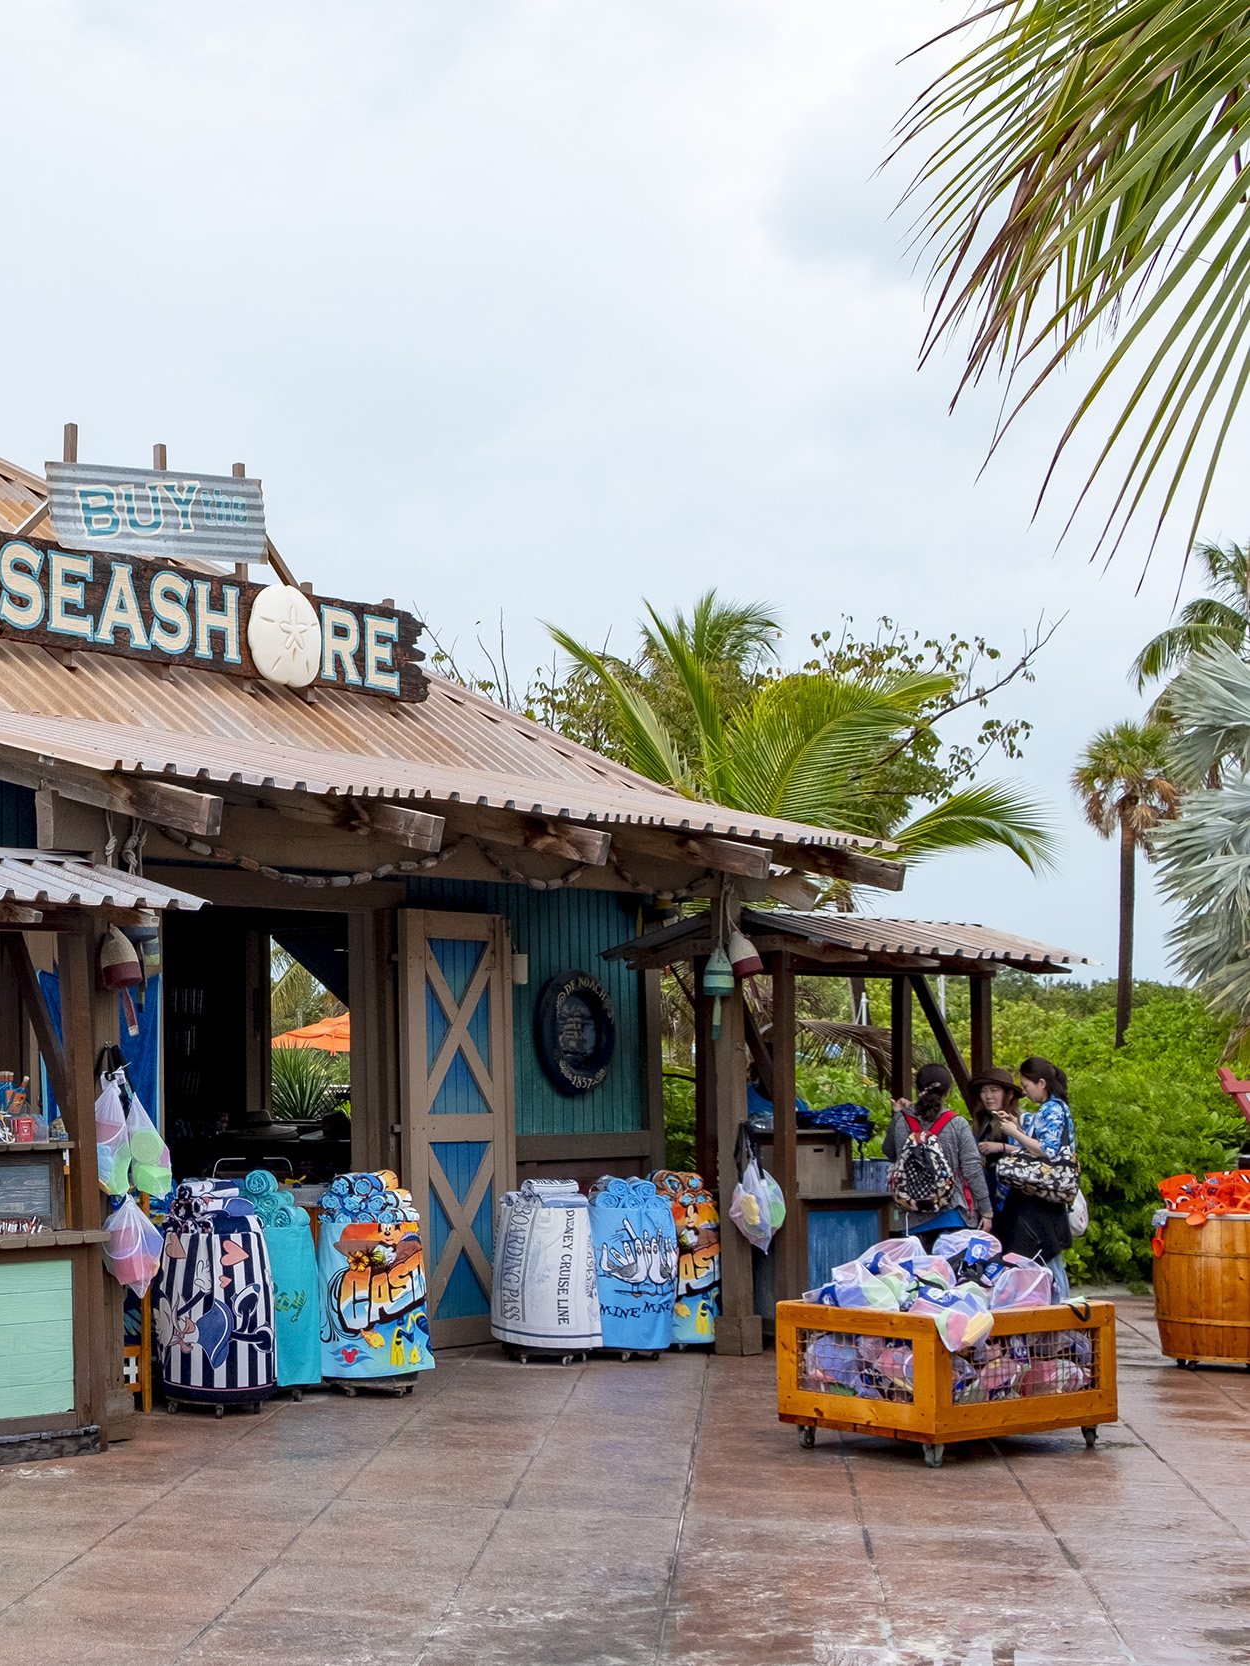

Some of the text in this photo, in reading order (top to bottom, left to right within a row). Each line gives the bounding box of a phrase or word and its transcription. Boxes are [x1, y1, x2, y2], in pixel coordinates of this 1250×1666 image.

[75, 480, 248, 540] BUY the
[577, 976, 608, 1002] NOACH
[571, 1075, 593, 1090] 1857
[338, 1249, 426, 1329] CAST
[502, 1205, 531, 1322] BOARDING PASS
[556, 1209, 576, 1326] DISNEY CRUISE LINE
[677, 1242, 720, 1297] AST
[273, 1282, 307, 1323] ay
[599, 1302, 641, 1319] MINE
